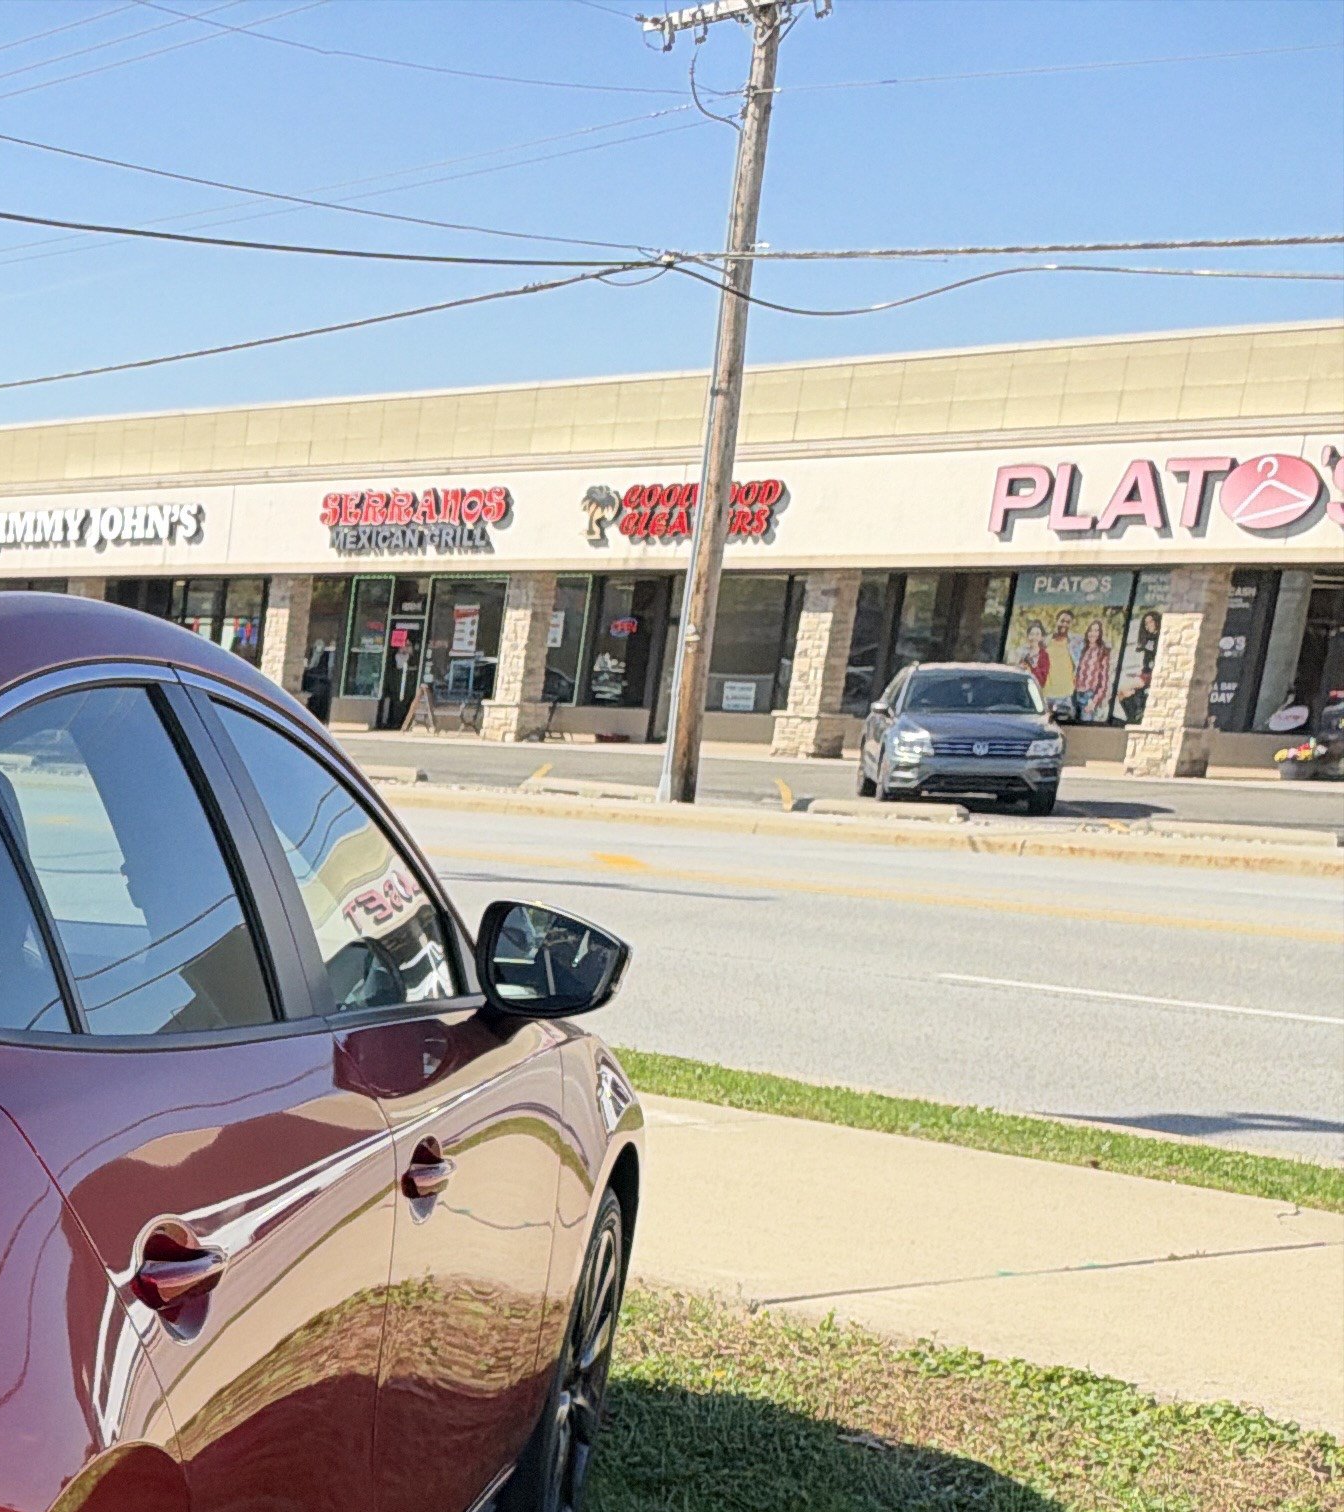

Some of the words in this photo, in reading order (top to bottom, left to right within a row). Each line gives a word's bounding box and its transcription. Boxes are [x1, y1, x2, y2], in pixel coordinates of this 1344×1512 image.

[319, 486, 507, 526] SERRANOS
[622, 479, 783, 509] COOLOD
[988, 444, 1344, 533] PLATO'
[83, 503, 200, 548] JOHN'S
[331, 526, 420, 550] MEXICAN
[425, 525, 488, 549] GRILL
[618, 505, 772, 537] CLEARS
